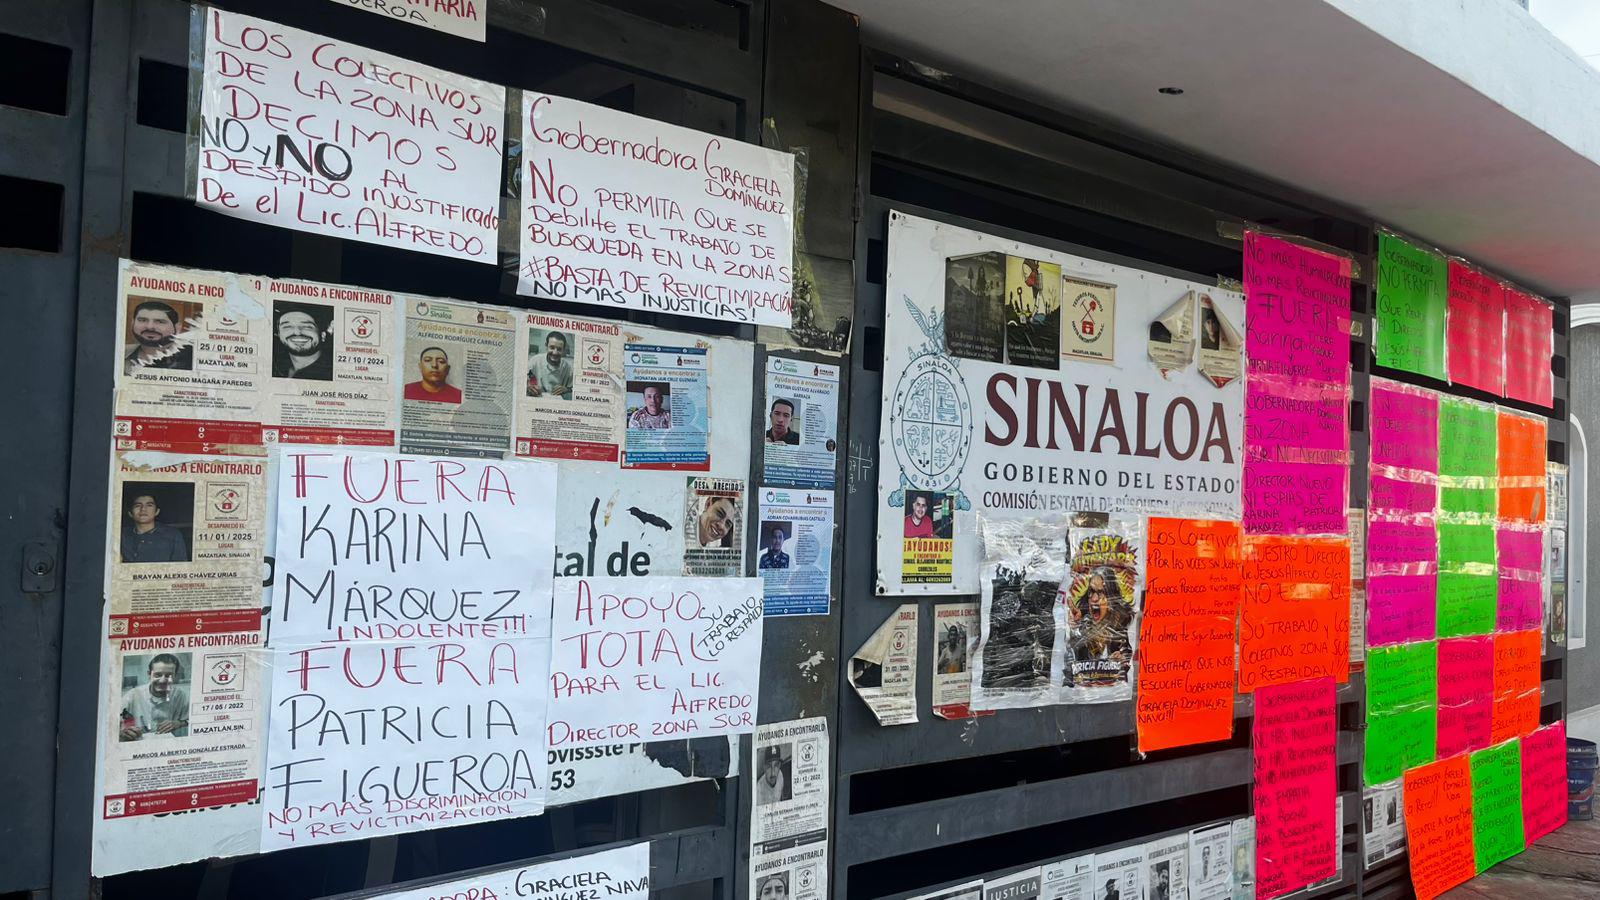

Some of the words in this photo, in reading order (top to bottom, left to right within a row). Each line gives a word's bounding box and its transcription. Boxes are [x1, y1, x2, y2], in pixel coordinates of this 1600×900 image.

[215, 10, 291, 58] LOS
[216, 51, 268, 86] DE
[294, 70, 341, 104] LA
[350, 89, 439, 131] ZONA
[448, 117, 501, 156] SUR
[530, 96, 698, 171] Gobernadora
[201, 114, 249, 152] NO
[275, 134, 352, 181] NO
[203, 150, 350, 198] DESPIDO
[380, 169, 417, 193] AL
[704, 139, 781, 197] GRACIELA
[594, 188, 684, 221] PERMITA
[694, 208, 736, 232] QUE
[743, 223, 766, 238] SE
[528, 224, 643, 262] BUSQUEDA
[652, 248, 682, 269] EN
[692, 258, 716, 274] LA
[628, 223, 655, 240] EL
[660, 228, 740, 256] TRABAJO
[750, 244, 776, 259] DE
[131, 276, 185, 294] AYUDANOS
[188, 284, 194, 294] A
[620, 270, 650, 293] DE
[1380, 264, 1400, 288] NO
[270, 281, 318, 298] AYUDANOS
[329, 289, 392, 305] ENCONTRARLO
[534, 280, 566, 298] NO
[574, 287, 626, 304] MAS
[642, 293, 756, 321] INJUSTICIAS!
[418, 332, 443, 340] ALFREDO
[445, 335, 476, 344] RODRÍGUEZ
[527, 314, 563, 328] AYUDANOS
[565, 321, 570, 329] A
[572, 322, 619, 336] ENCONTRARLO
[159, 375, 189, 383] ANTONIO
[222, 379, 253, 387] PAREDES
[917, 360, 953, 376] SINALOA
[984, 372, 1235, 464] SINALOA
[181, 463, 187, 472] A
[191, 462, 262, 475] ENCONTRARLO
[287, 454, 516, 505] FUERA
[984, 462, 1107, 487] GOBIERNO
[1118, 471, 1154, 489] DEL
[1164, 474, 1235, 494] ESTADO
[1244, 466, 1294, 490] DIRECTOR
[920, 478, 941, 487] 1831
[983, 490, 1047, 510] COMISIÓN
[300, 504, 491, 572] KARINA
[1150, 518, 1175, 545] LOS
[607, 541, 650, 576] de
[1304, 545, 1346, 564] DIRECTOR
[576, 580, 701, 625] APOYO
[1244, 583, 1271, 604] NO
[698, 606, 723, 632] SU
[698, 596, 755, 648] TRABAJO
[1242, 610, 1264, 641] SU
[1268, 618, 1318, 634] TRABAJO
[120, 638, 175, 650] AYUDANOS
[178, 637, 185, 648] A
[188, 633, 259, 647] ENCONTRARLO
[561, 628, 718, 669] TOTAL
[709, 640, 725, 656] LO
[1242, 643, 1293, 665] COLECTIVOS
[1300, 642, 1328, 654] ZONA
[287, 643, 519, 691] FUERA
[1240, 668, 1255, 686] LO
[551, 672, 620, 698] PARA
[634, 674, 665, 690] EL
[672, 688, 752, 714] ALFREDO
[279, 694, 518, 750] PATRICIA
[548, 721, 640, 746] DIRECTOR
[652, 719, 698, 736] ZONA
[710, 712, 753, 728] SUR
[758, 729, 784, 741] AYUDANOS
[790, 723, 825, 736] ENCONTRARLO
[550, 769, 575, 790] 53
[269, 806, 302, 828] NO
[309, 801, 372, 818] MAS
[387, 789, 527, 813] DISCRIMINACION
[755, 861, 782, 873] AYUDANOS
[788, 848, 823, 864] ENCONTRARLO
[515, 869, 611, 897] GRACIELA
[990, 881, 1037, 900] JUSTICIA
